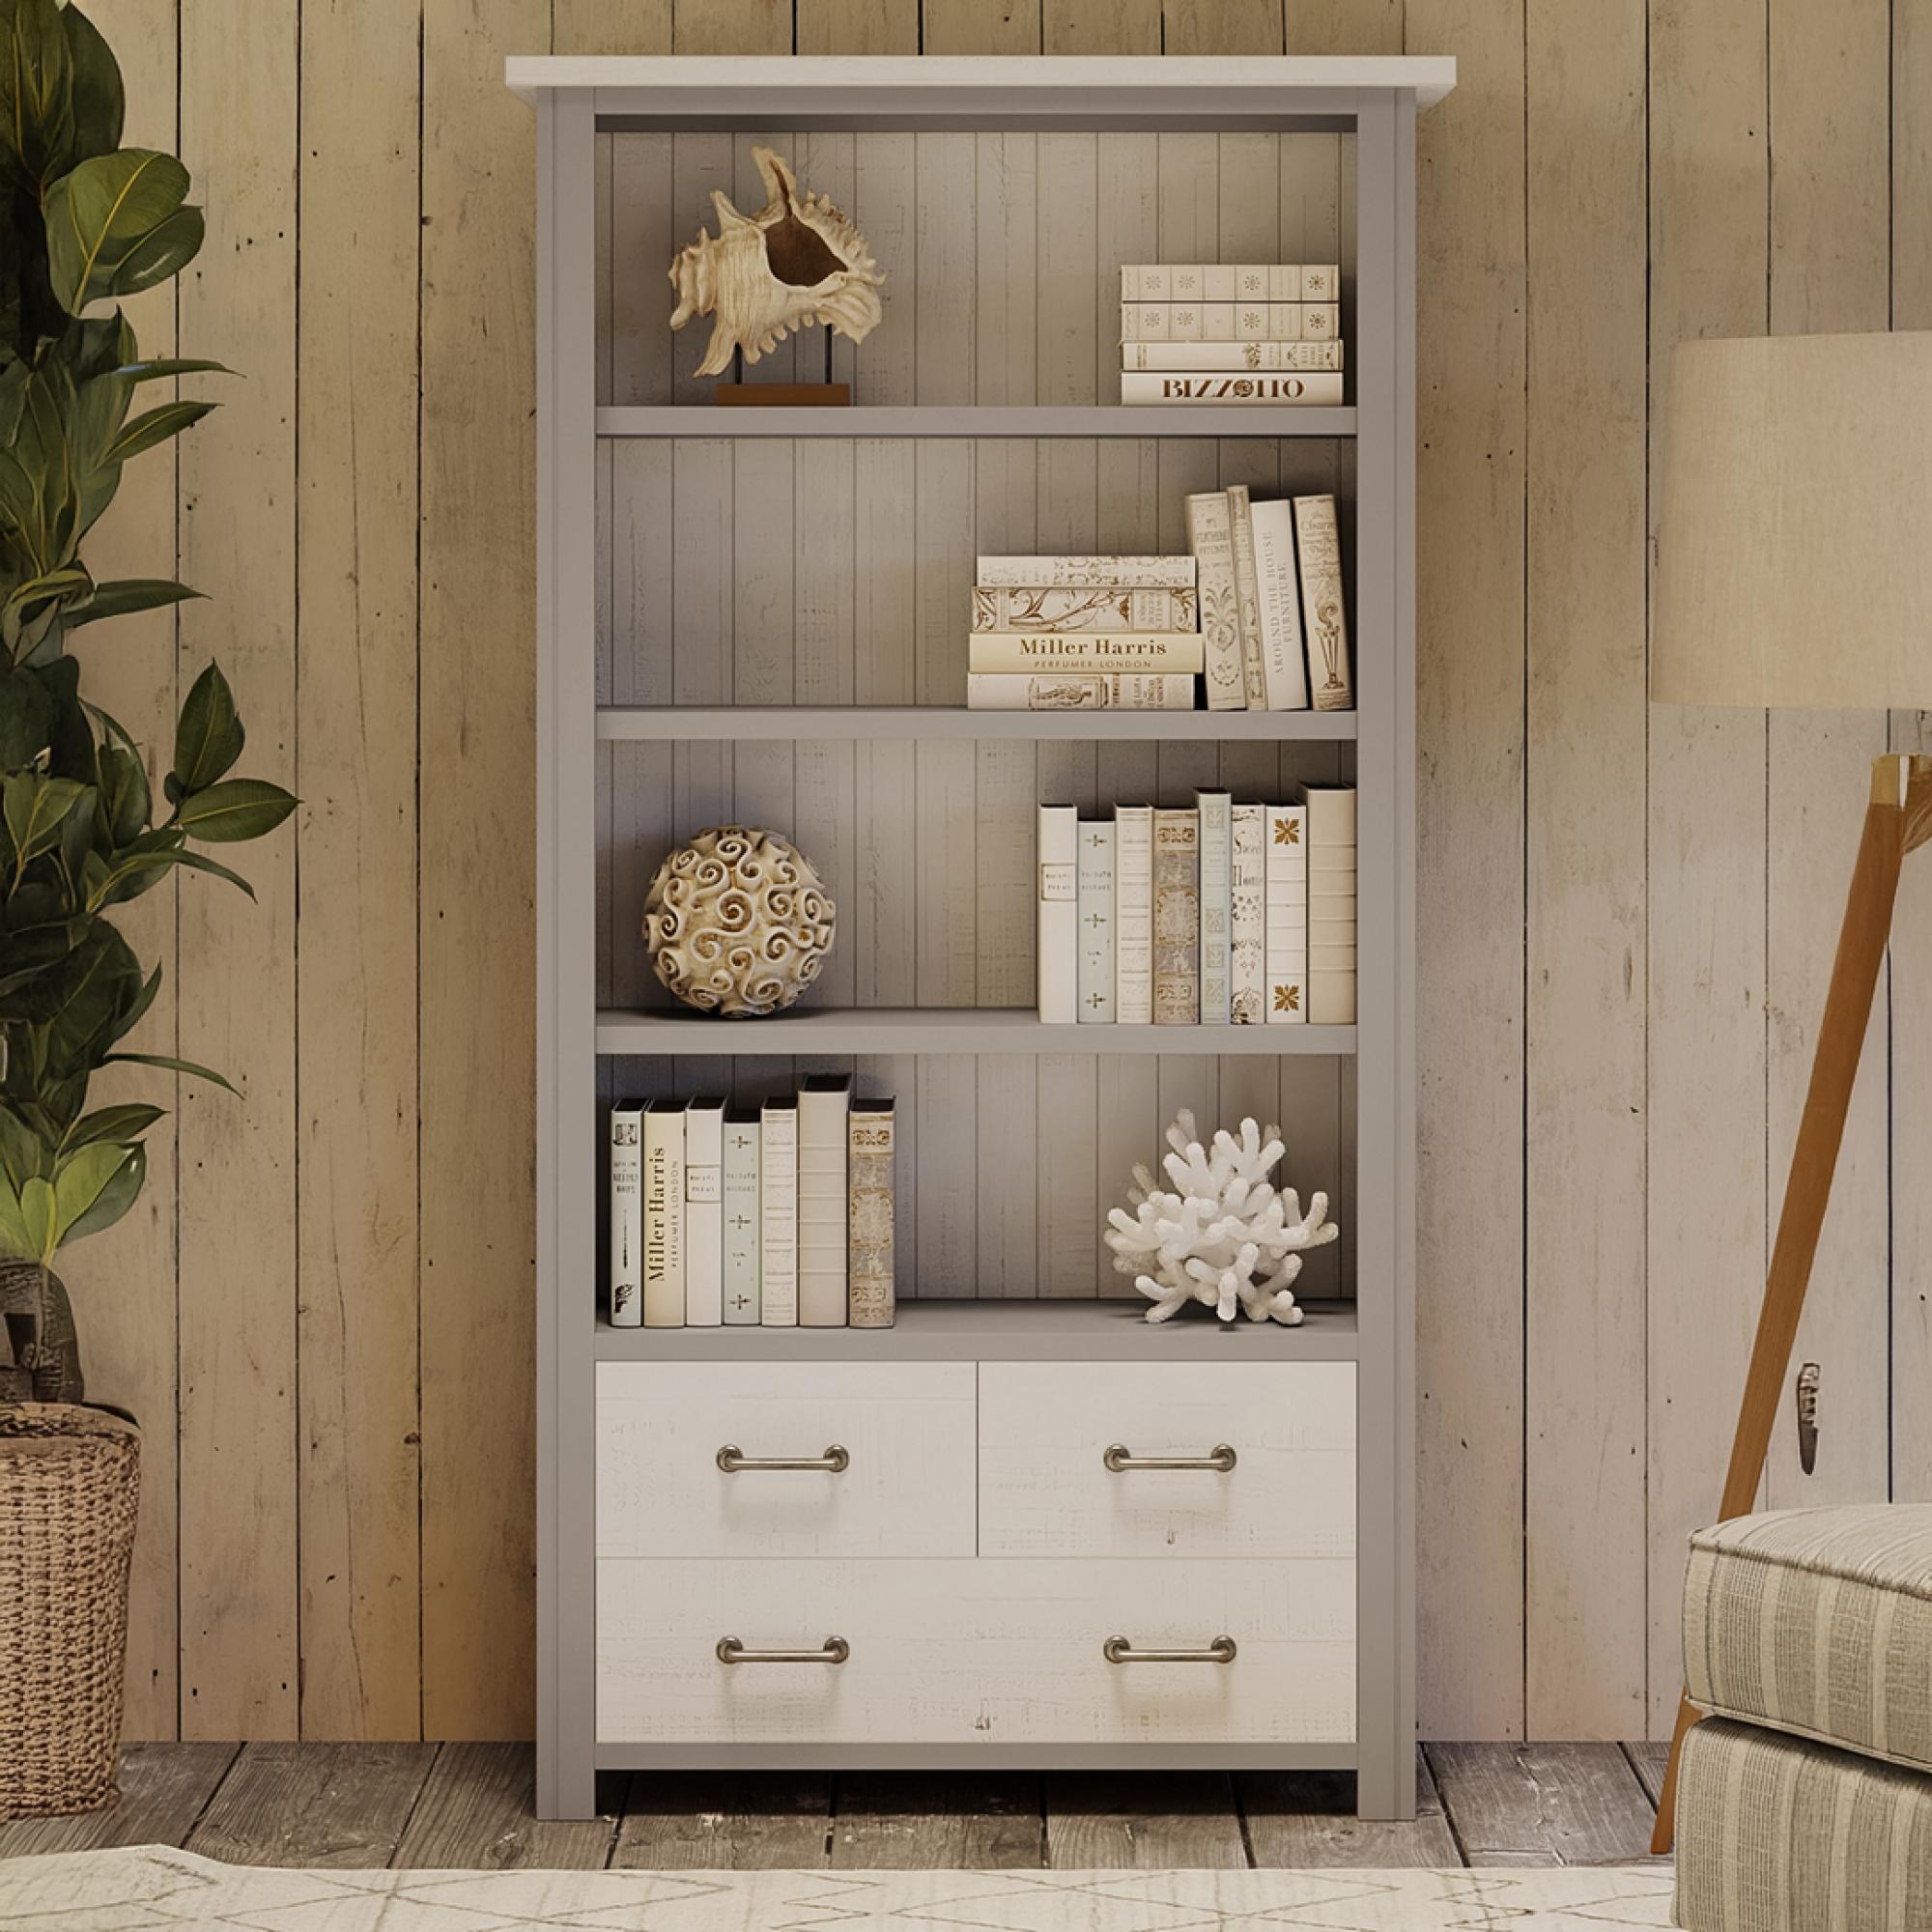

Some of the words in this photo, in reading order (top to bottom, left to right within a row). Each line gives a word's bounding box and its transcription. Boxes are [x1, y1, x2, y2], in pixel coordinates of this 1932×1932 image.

[1263, 531, 1276, 579] HOUSE
[1266, 585, 1280, 612] THE
[1276, 563, 1293, 644] FURNITURE
[1019, 639, 1089, 656] Miller
[1094, 639, 1168, 656] Harris
[1099, 660, 1151, 668] LONDON
[1269, 617, 1285, 674] AROUND
[648, 1147, 665, 1212] Harris
[670, 1160, 679, 1208] LONDON
[648, 1219, 665, 1282] Miller
